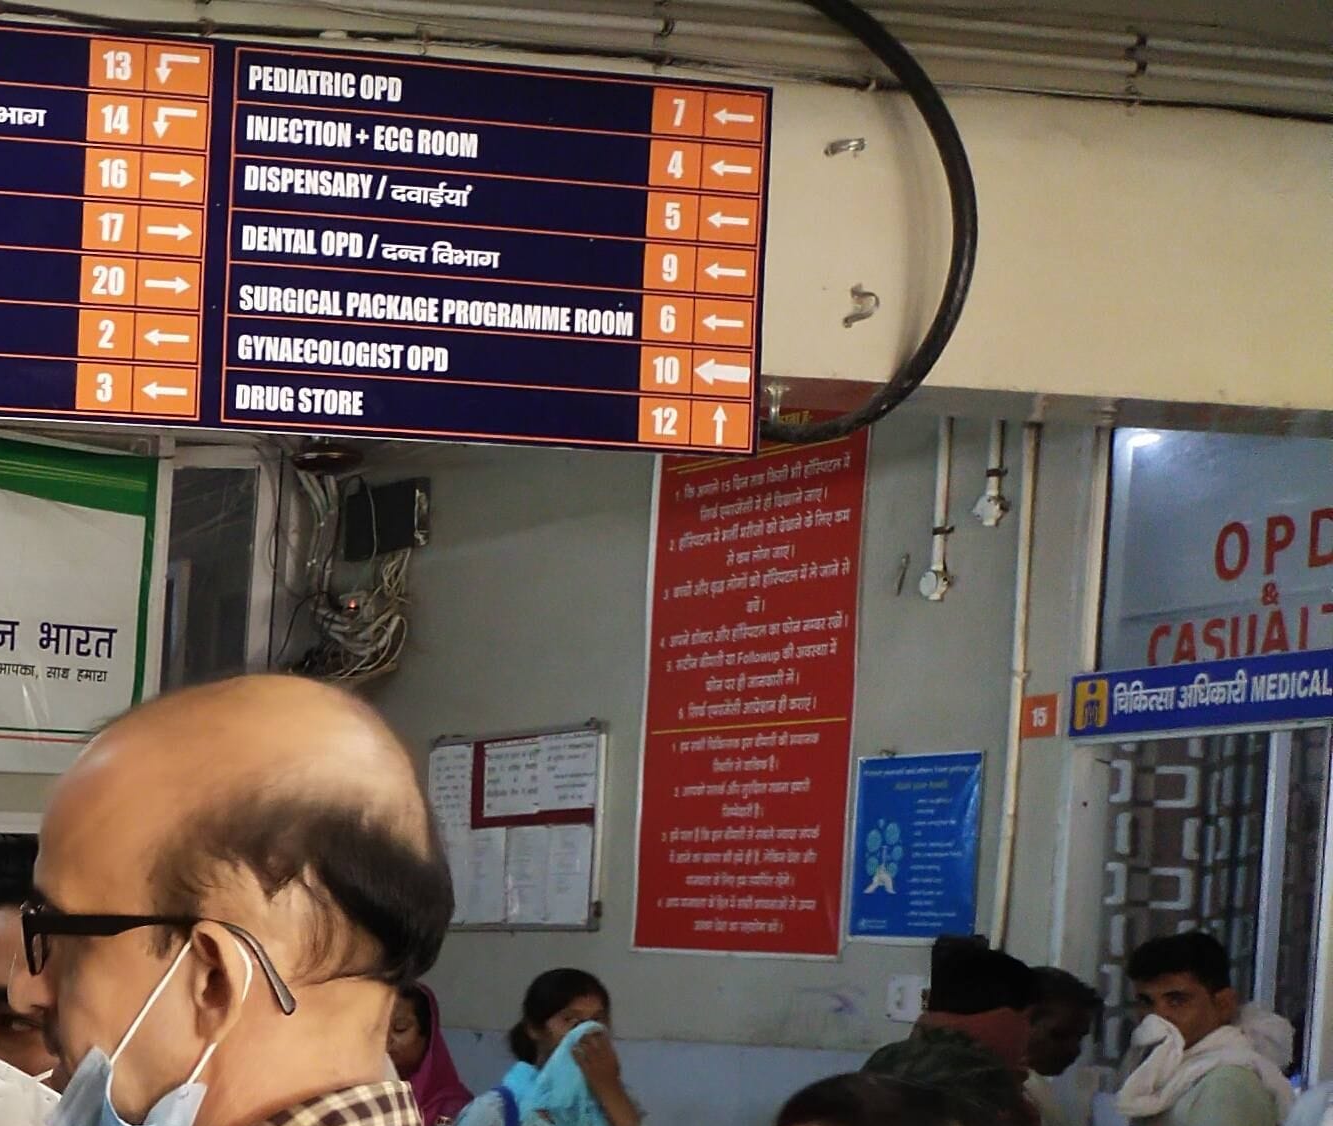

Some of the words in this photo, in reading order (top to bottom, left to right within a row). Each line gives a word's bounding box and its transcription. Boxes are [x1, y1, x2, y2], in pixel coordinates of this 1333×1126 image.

[103, 51, 131, 80] 13
[249, 66, 355, 97] PEDIATRIC
[360, 75, 401, 101] OPD
[101, 105, 129, 134] 14
[674, 100, 684, 125] 7
[247, 115, 351, 147] INJECTION
[356, 129, 369, 144] +
[374, 126, 413, 152] ECG
[418, 129, 478, 158] ROOM
[99, 159, 127, 188] 16
[668, 151, 682, 178] 4
[245, 166, 373, 198] DISPENSARY
[376, 176, 387, 200] /
[391, 182, 472, 207] दवाईयां
[99, 213, 124, 241] 17
[665, 203, 680, 230] 5
[242, 225, 317, 254] DENTAL
[321, 231, 363, 257] OPD
[367, 234, 378, 259] /
[381, 244, 428, 262] दन्त
[432, 241, 500, 268] विभाग
[92, 265, 125, 296] 20
[663, 254, 677, 282] 9
[240, 285, 342, 315] SURGICAL
[346, 292, 438, 322] PACKAGE
[442, 300, 571, 334] PROGRAMME
[575, 309, 633, 336] ROOM
[660, 305, 675, 333] 6
[98, 320, 114, 348] 2
[238, 335, 404, 369] GYNAECOLOGIST
[407, 345, 448, 371] OPD
[653, 357, 679, 384] 10
[96, 373, 112, 402] 3
[236, 385, 294, 411] DRUG
[298, 388, 363, 415] STORE
[652, 408, 677, 435] 12
[1262, 583, 1279, 605] &
[38, 622, 117, 659] भारत
[46, 666, 69, 679] साथ
[76, 668, 107, 682] हमारा
[1249, 669, 1331, 702] MEDICAL
[1033, 707, 1047, 727] 15
